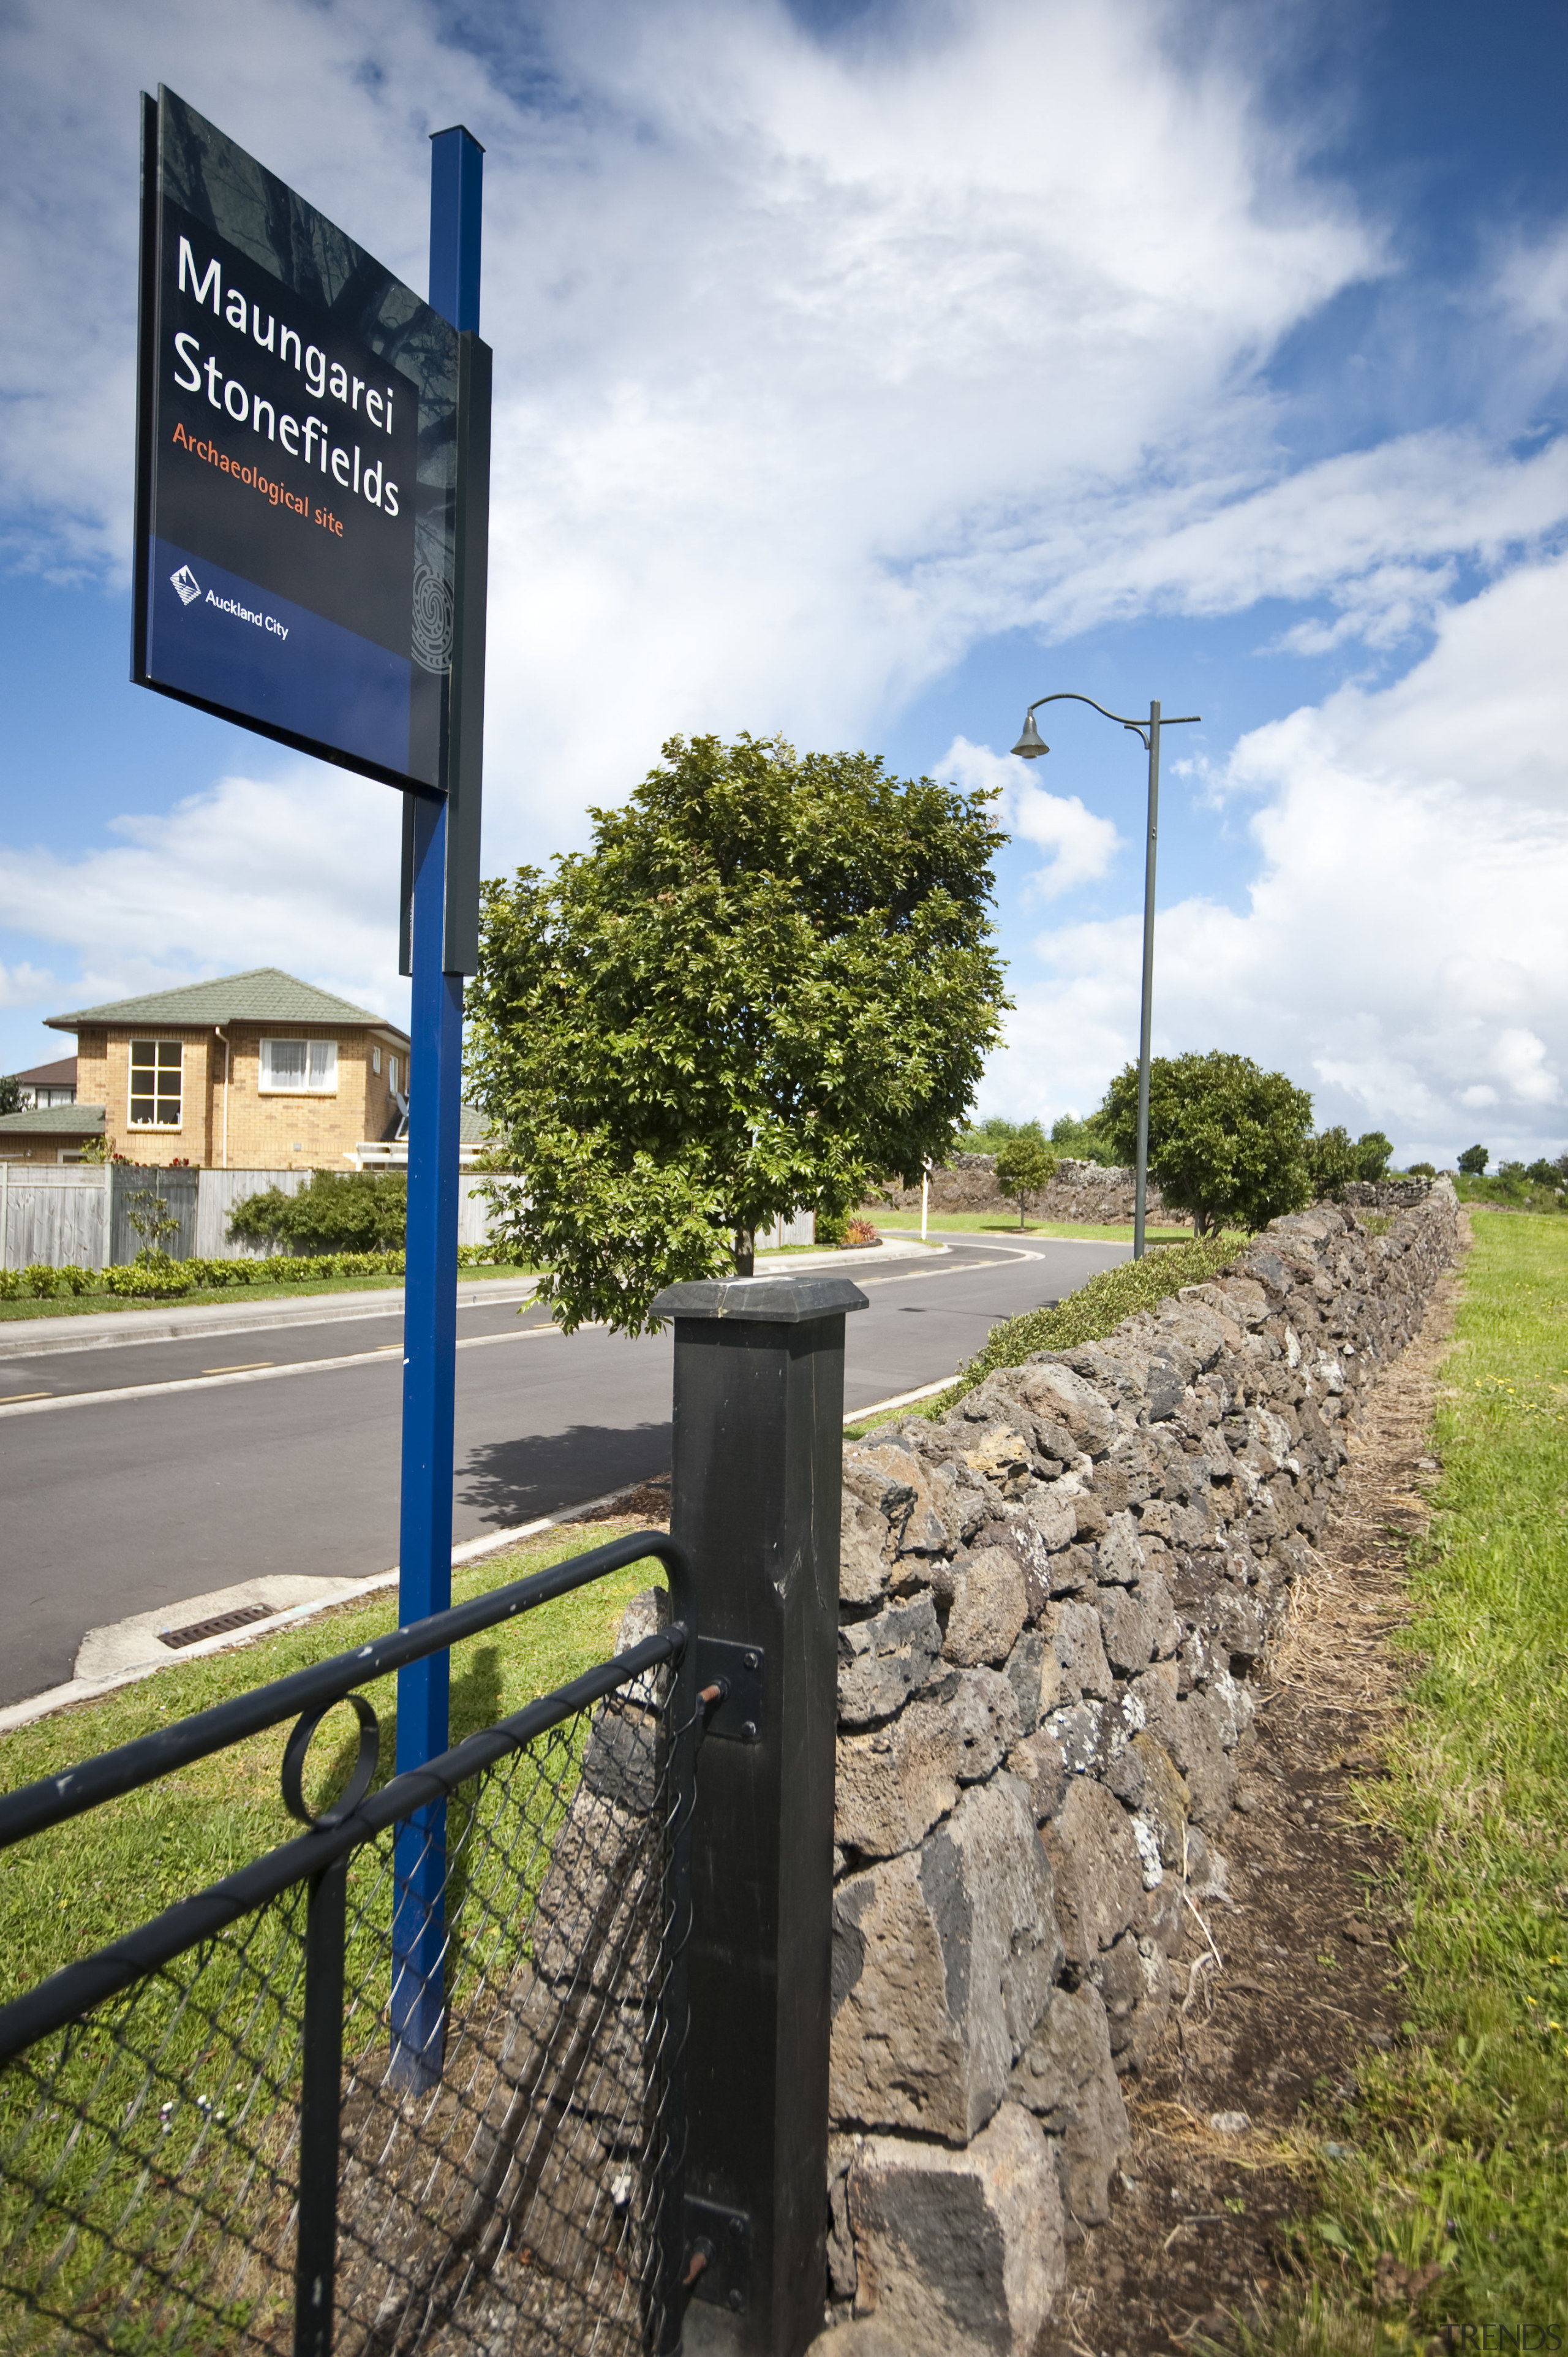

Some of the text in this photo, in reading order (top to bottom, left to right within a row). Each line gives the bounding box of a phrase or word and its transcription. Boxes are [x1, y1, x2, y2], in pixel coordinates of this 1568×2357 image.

[178, 235, 393, 436] Maungarei
[172, 422, 344, 537] Archaeological site
[174, 332, 399, 517] Stonefields
[205, 589, 289, 641] Auckland City
